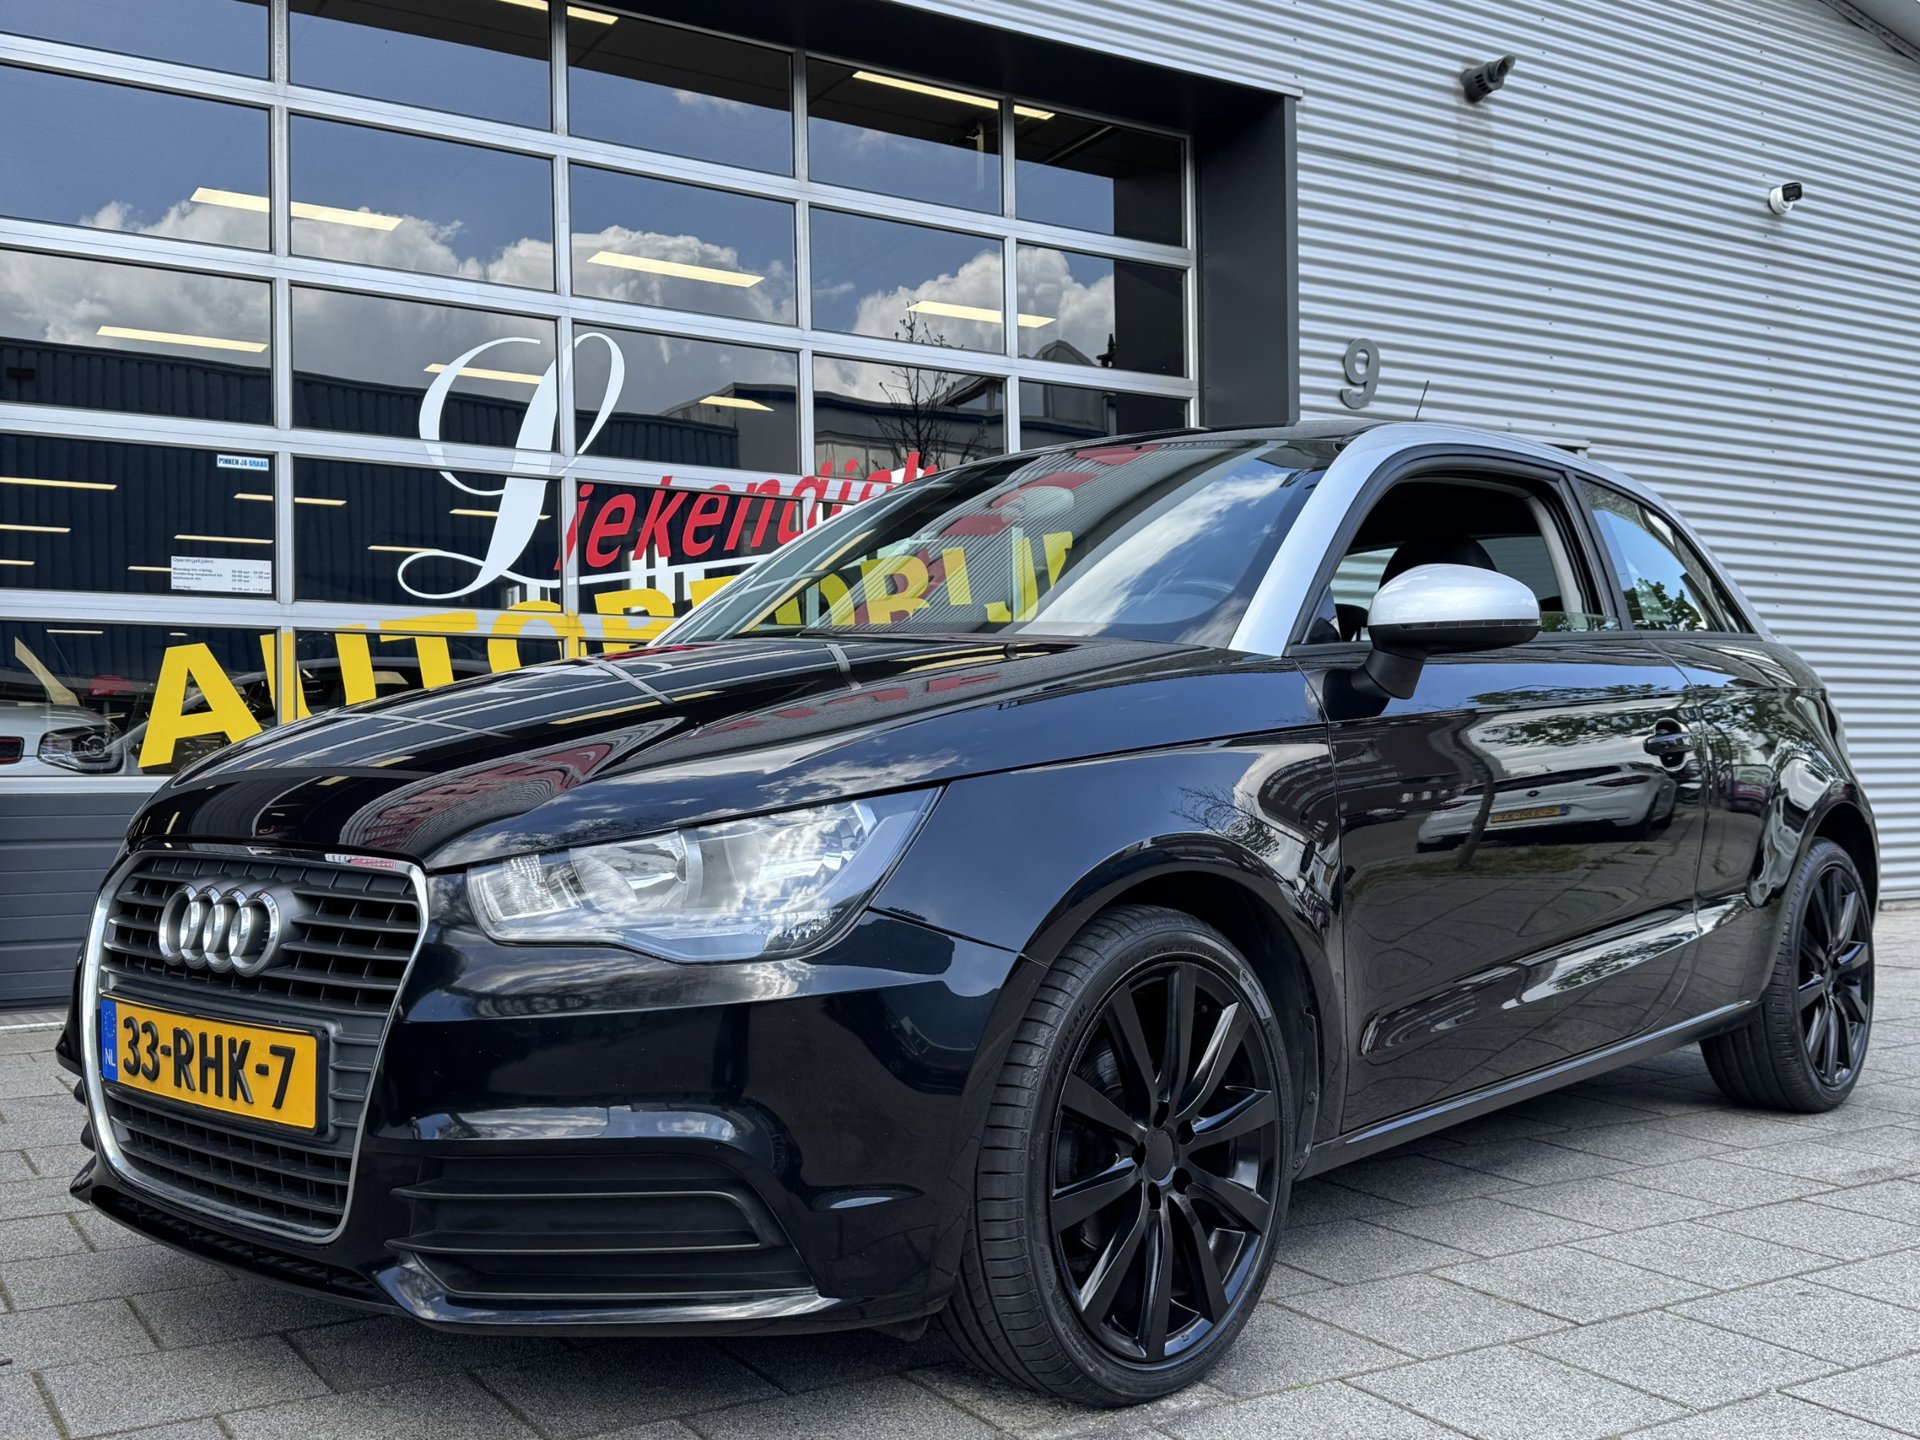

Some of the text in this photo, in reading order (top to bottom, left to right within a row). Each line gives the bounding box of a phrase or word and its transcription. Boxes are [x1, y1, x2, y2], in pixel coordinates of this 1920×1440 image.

[1340, 338, 1380, 409] 9
[240, 459, 248, 467] JA
[104, 1048, 116, 1067] NL
[123, 1016, 295, 1109] 33-RHK-7
